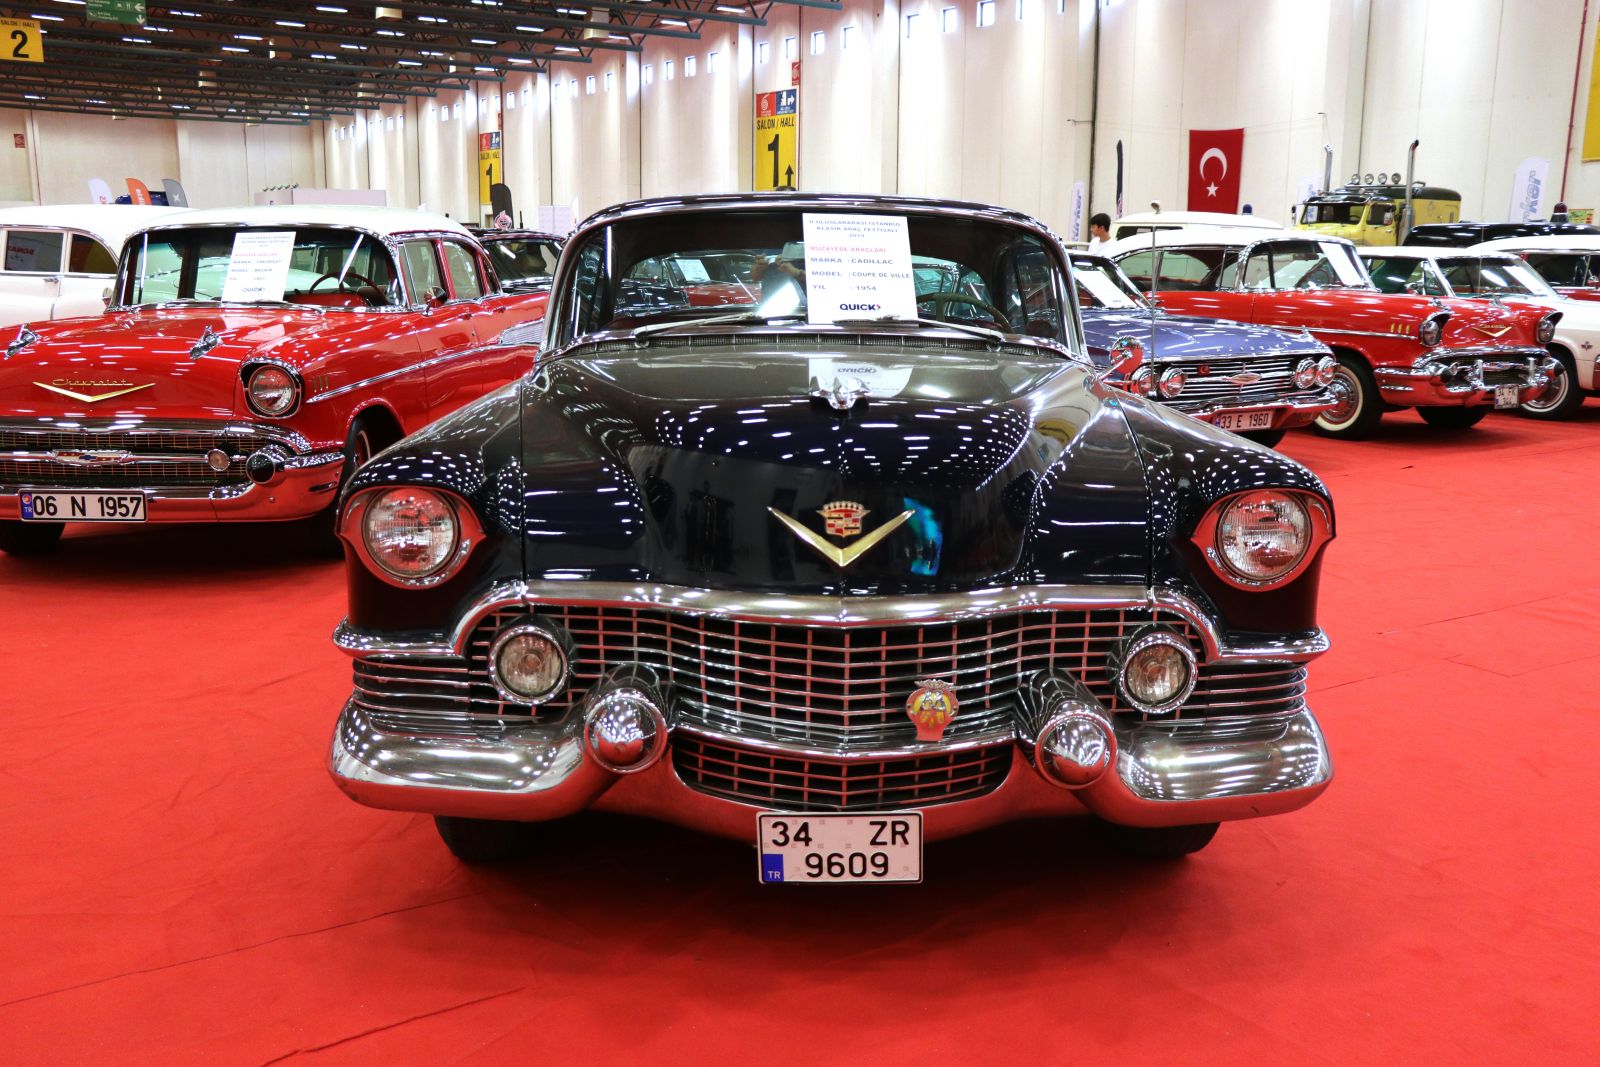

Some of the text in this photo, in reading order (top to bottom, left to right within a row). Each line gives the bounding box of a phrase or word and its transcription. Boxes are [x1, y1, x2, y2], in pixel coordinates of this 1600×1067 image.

[10, 30, 29, 58] 2
[756, 118, 776, 130] SALON
[780, 116, 795, 127] HALL
[767, 133, 780, 188] 1
[1221, 413, 1269, 428] 33 E 1960
[33, 496, 142, 518] 06 N 1957
[772, 820, 910, 846] 34 ZR
[768, 870, 780, 879] TR
[805, 852, 888, 878] 9609
